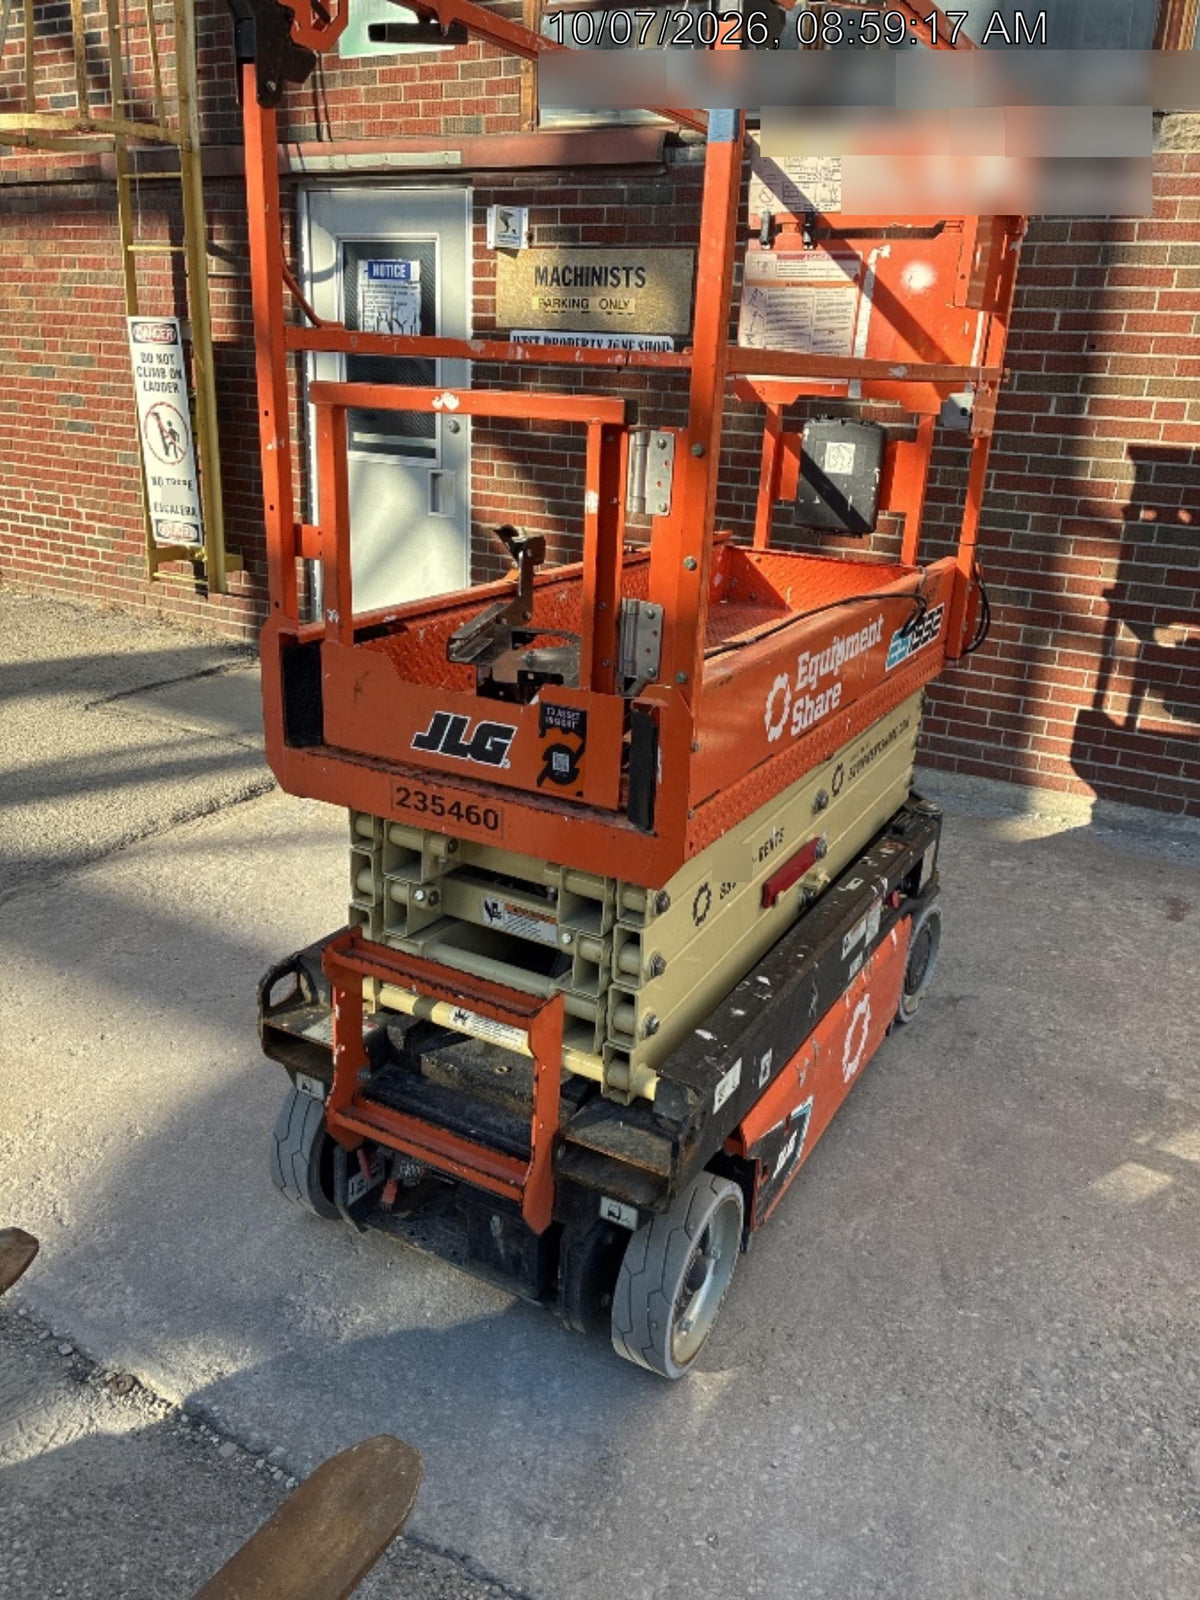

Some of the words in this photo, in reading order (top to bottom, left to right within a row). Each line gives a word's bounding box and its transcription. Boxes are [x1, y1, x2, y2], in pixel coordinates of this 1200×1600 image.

[372, 263, 406, 278] NOTICE
[534, 266, 647, 289] MACHINISTS
[539, 298, 589, 310] PARKING
[599, 298, 630, 310] ONLY
[140, 352, 154, 363] DO
[156, 353, 175, 365] NOT
[136, 366, 167, 379] CLIMB
[170, 369, 182, 380] ON
[143, 381, 180, 394] LADDER
[795, 613, 885, 691] Equipment
[791, 682, 842, 736] Share
[410, 710, 518, 768] JLG
[395, 786, 500, 831] 235460
